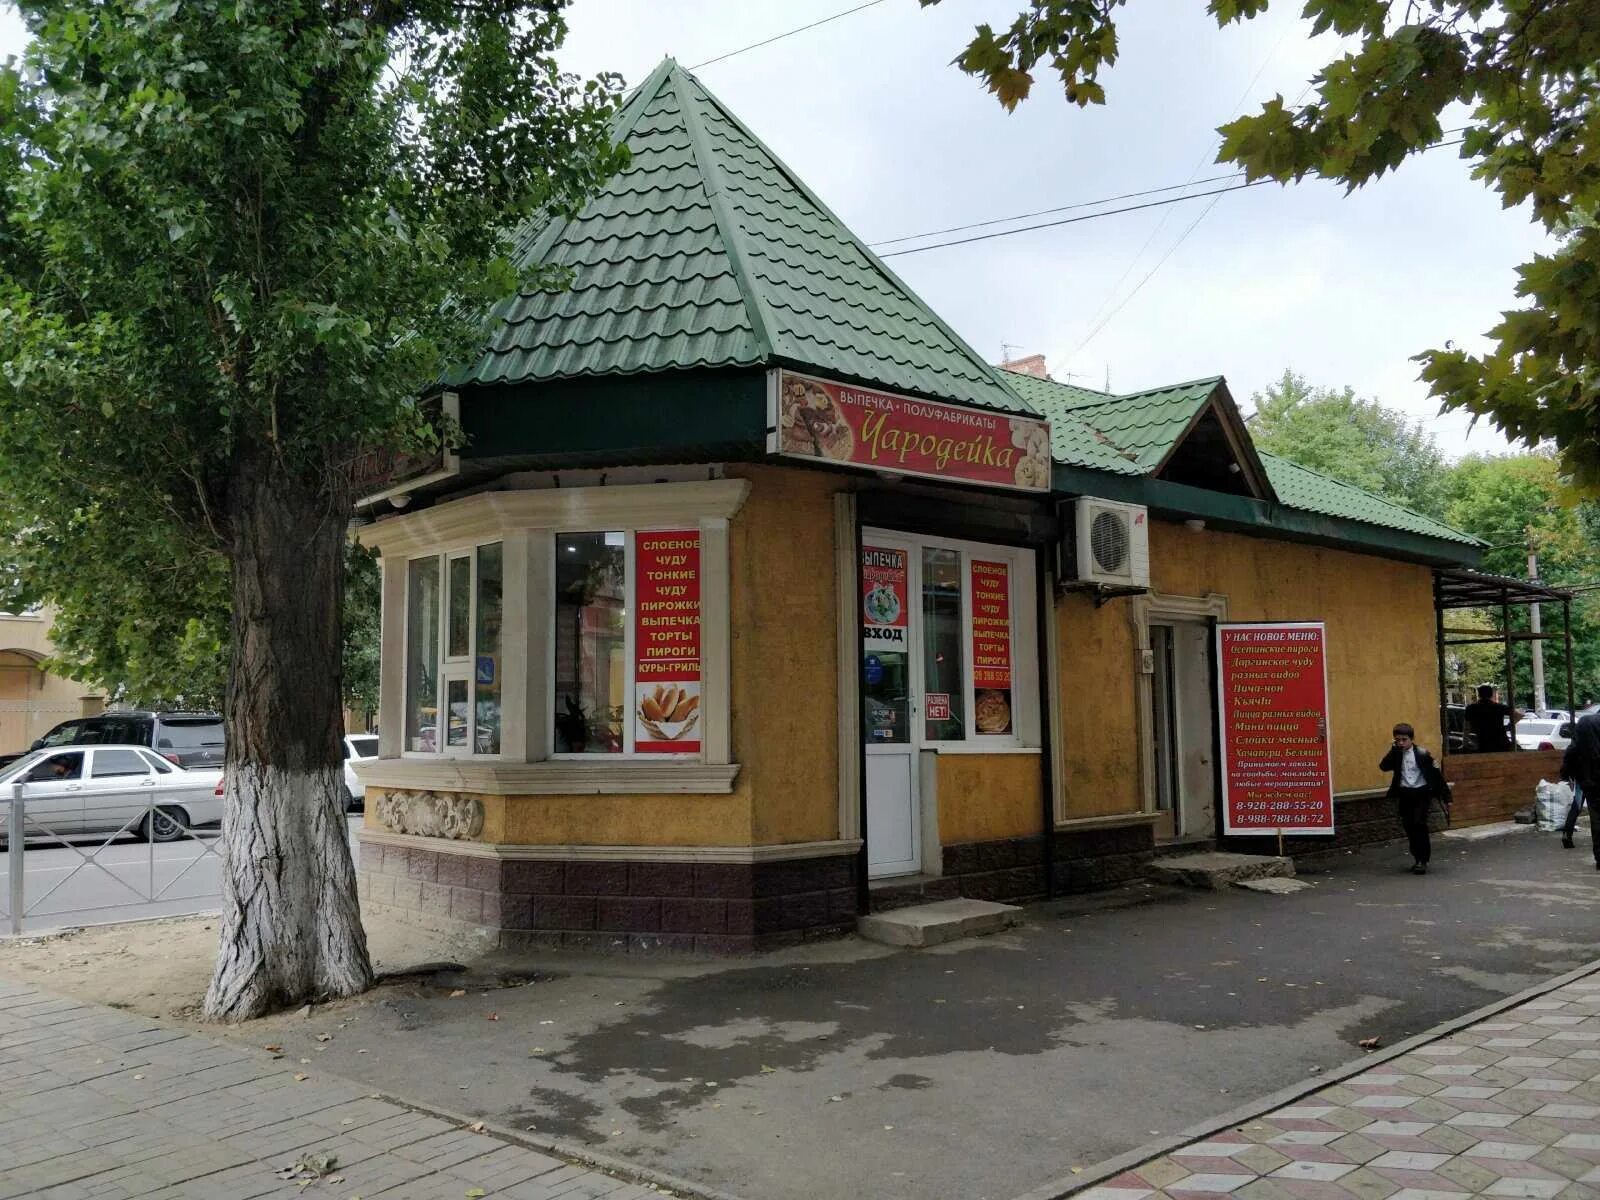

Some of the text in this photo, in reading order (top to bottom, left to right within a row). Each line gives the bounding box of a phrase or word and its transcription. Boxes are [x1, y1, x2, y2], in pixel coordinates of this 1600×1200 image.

[840, 390, 996, 429] ВЫПЕЧКА ПОЛУФАБРИКАТЫ
[860, 409, 1013, 470] Чародейка
[643, 540, 700, 550] СЛОЕНОЕ
[656, 555, 687, 565] ЧУДУ
[863, 551, 903, 569] ЫПЕЧКА
[648, 570, 695, 580] ТОНКИЕ
[980, 579, 1000, 588] ЧУДУ
[656, 586, 687, 596] ЧУДУ
[976, 591, 1006, 601] ТОНКИЕ
[980, 604, 1000, 614] ЧУДУ
[641, 616, 701, 626] ВЫПЕЧКА
[650, 631, 692, 641] ТОРТЫ
[864, 626, 903, 643] ВХОД
[1224, 632, 1320, 641] У НАС НОВОЕ МЕНЮ:
[646, 647, 695, 657] ПИРОГИ
[979, 643, 1005, 652] ТОРТЫ
[976, 655, 1007, 665] ПИРОГИ
[1231, 672, 1268, 681] разных
[1262, 711, 1294, 720] разных
[1235, 722, 1299, 731] Мини пицца
[1236, 801, 1323, 810] 8-928-288-55-20
